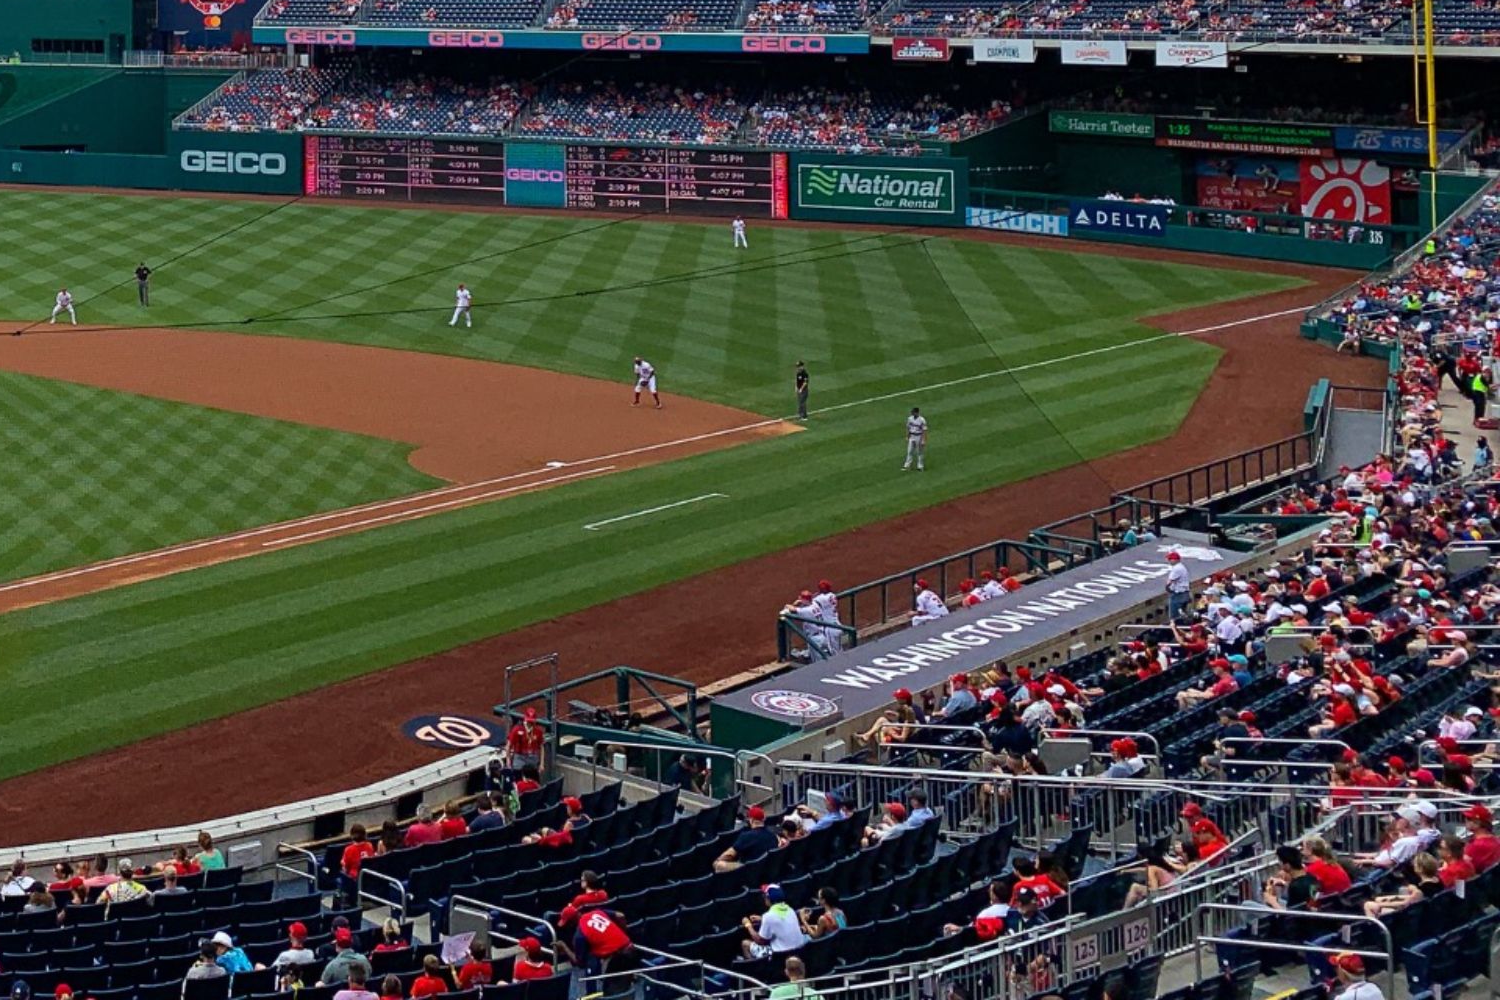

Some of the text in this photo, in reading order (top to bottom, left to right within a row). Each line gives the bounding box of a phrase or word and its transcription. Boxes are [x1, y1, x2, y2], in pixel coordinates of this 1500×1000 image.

[285, 29, 355, 45] GEICO
[429, 31, 503, 48] GEICO
[581, 32, 662, 50] GEICO
[742, 34, 826, 53] GEICO
[1069, 119, 1151, 134] Harris Teeter
[1169, 124, 1191, 135] 1:35
[181, 150, 286, 175] GEICO
[507, 168, 563, 182] GEICO
[875, 197, 938, 209] Car Rental
[1097, 211, 1161, 230] DELTA
[1369, 231, 1383, 244] 335
[1027, 560, 1172, 622] NATIONALS
[821, 609, 1032, 689] WASHINGTON
[1127, 923, 1148, 944] 126
[1074, 940, 1096, 962] 125
